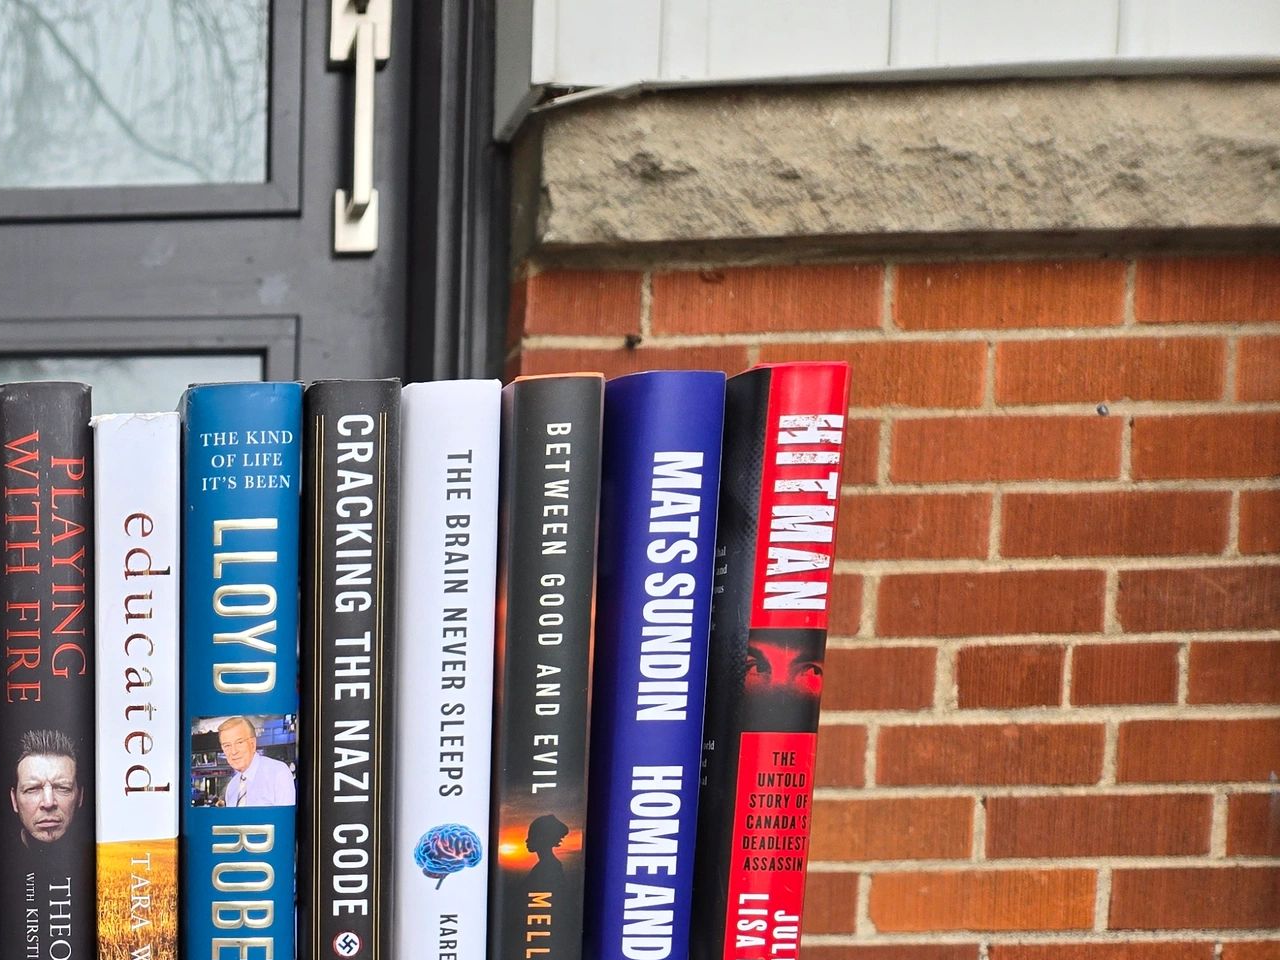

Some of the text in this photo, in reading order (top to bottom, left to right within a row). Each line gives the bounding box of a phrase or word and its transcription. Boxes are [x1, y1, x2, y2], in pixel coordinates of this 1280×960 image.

[200, 430, 294, 446] THE KIND
[211, 453, 283, 469] OF LIFE
[201, 475, 292, 491] IT'S BEEN
[646, 451, 704, 564] MATS
[763, 414, 845, 610] HITMAN
[3, 430, 42, 703] WITH FIRE
[51, 456, 86, 679] PLAYING
[213, 518, 278, 694] LLOYD
[438, 449, 473, 797] THE BRAIN NEVER SLEEPS
[531, 422, 572, 794] BETWEEN GOOD AND EVIL
[635, 572, 696, 722] SUNDIN
[123, 512, 171, 797] educated
[332, 414, 375, 917] CRACKING THE NAZI CODE
[757, 773, 806, 788] UNTOLD
[773, 751, 796, 766] THE
[626, 765, 683, 877] HOME
[746, 815, 808, 829] CANADA'S
[749, 794, 808, 808] STORY OF
[742, 836, 807, 850] DEADLIEST
[743, 857, 803, 871] ASSASSIN
[25, 872, 36, 901] WITH
[131, 853, 153, 932] TARA
[735, 893, 769, 948] LISA
